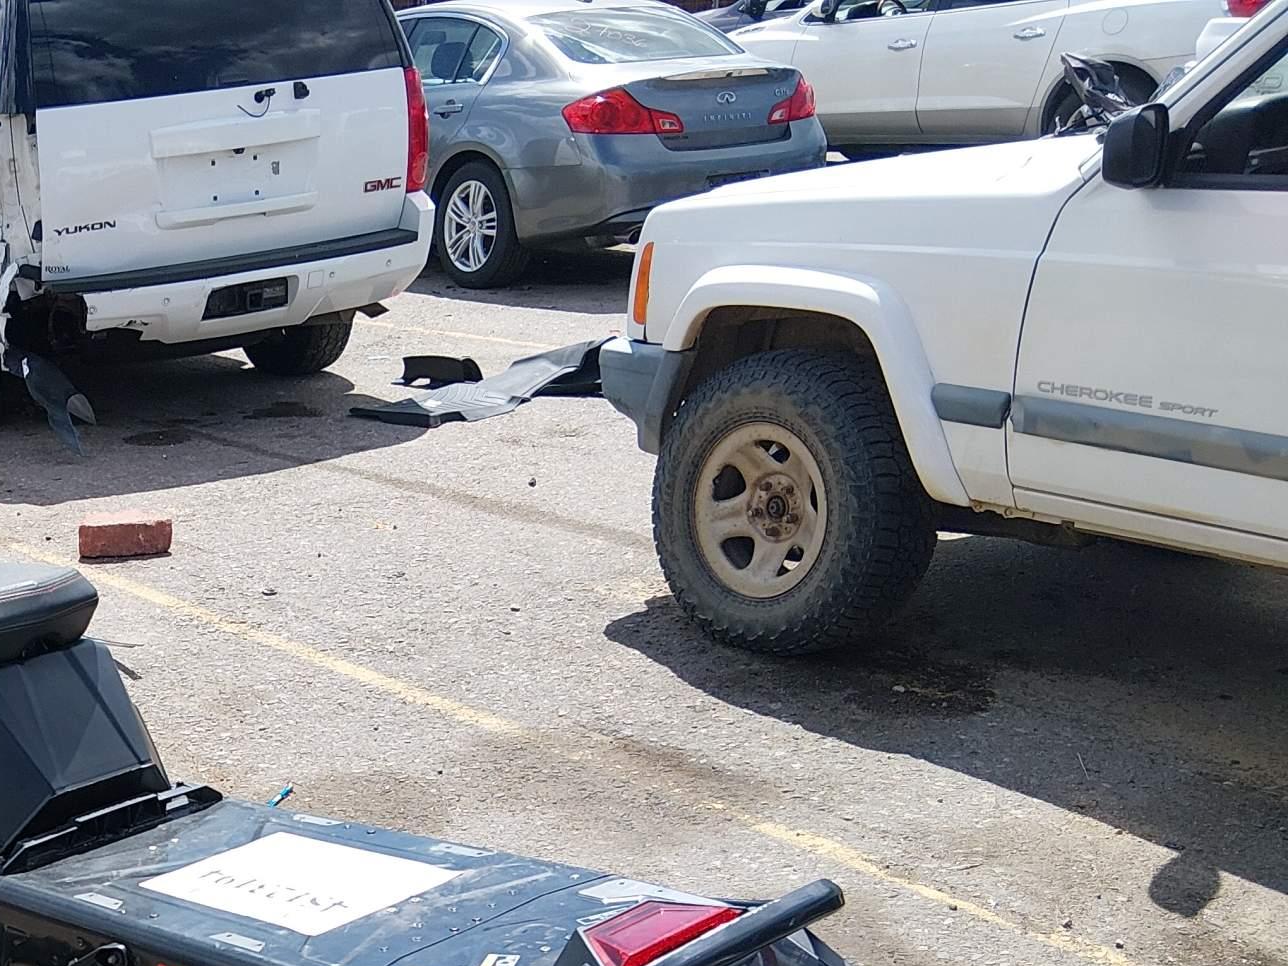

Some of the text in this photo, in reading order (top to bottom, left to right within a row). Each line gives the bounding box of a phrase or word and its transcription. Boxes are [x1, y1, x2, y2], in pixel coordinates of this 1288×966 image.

[363, 176, 402, 193] GMC
[53, 219, 117, 237] YUKON
[45, 265, 71, 274] ROYAL
[1037, 380, 1219, 418] CHEROKEE SPORT
